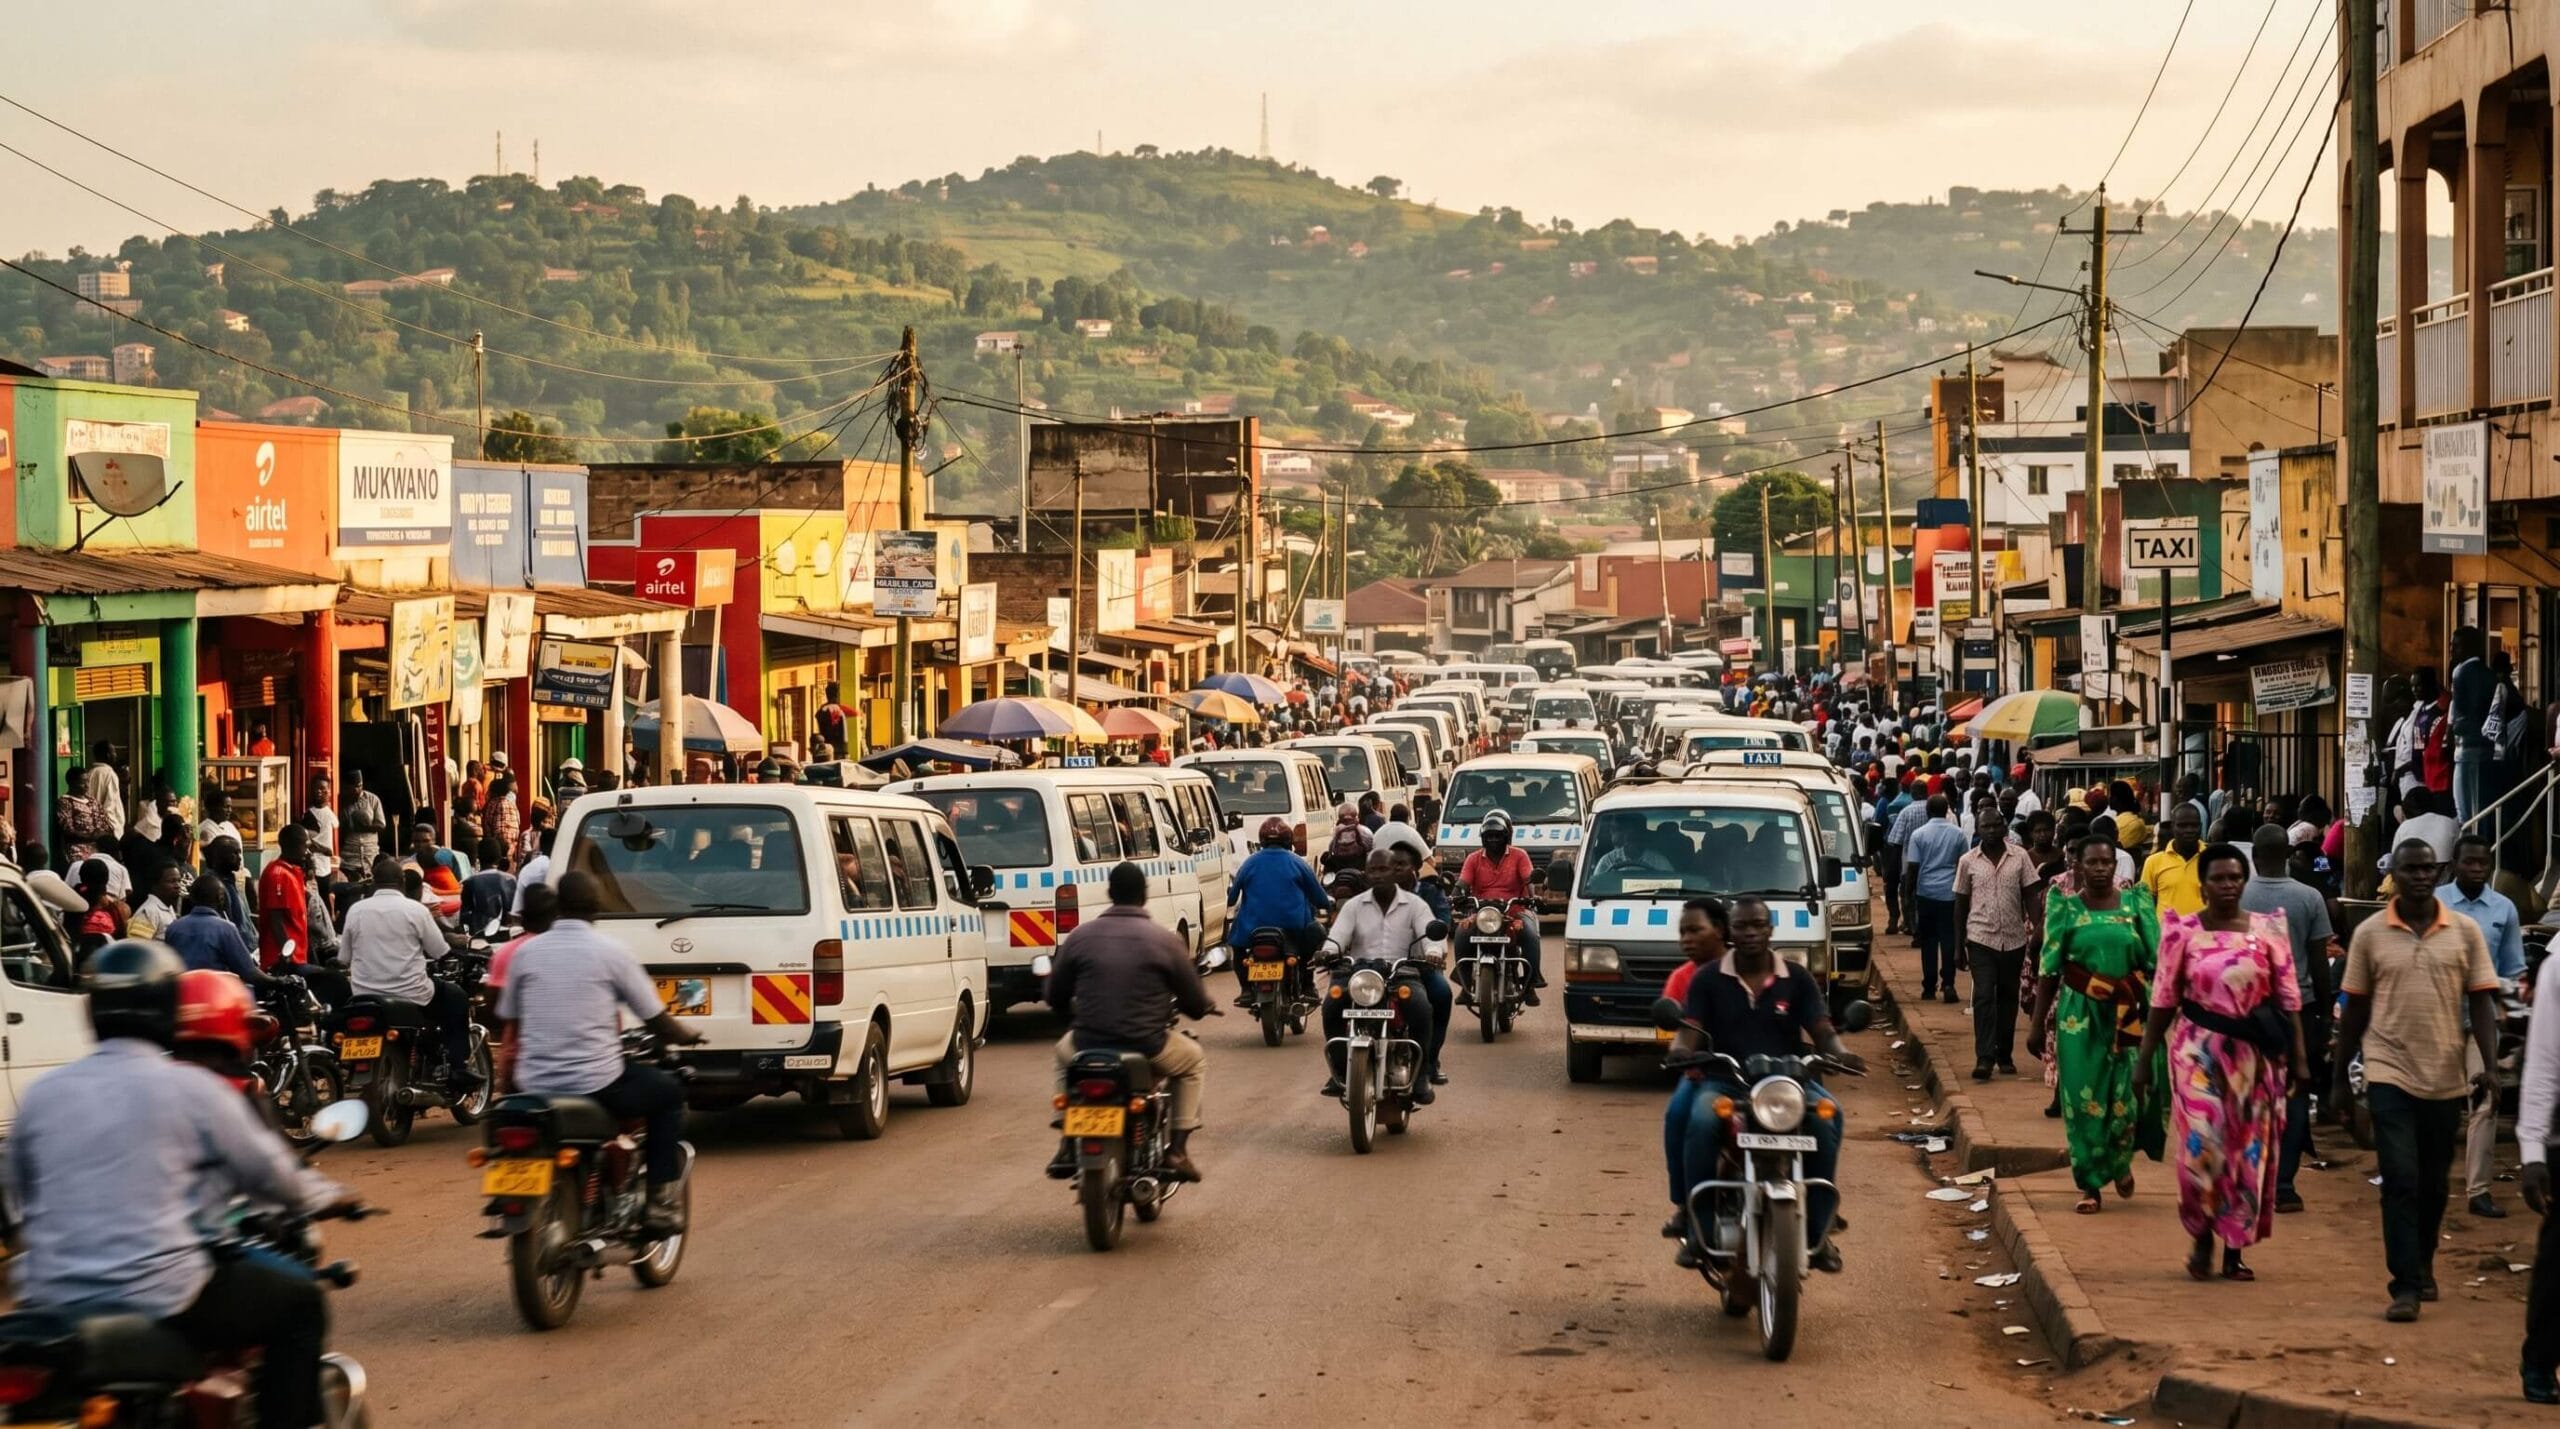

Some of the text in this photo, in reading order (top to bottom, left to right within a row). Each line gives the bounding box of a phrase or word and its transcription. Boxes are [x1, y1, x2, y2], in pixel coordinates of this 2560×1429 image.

[353, 466, 439, 500] MUKWANO
[245, 495, 287, 531] airtel
[2134, 537, 2194, 559] TAXI
[645, 579, 686, 594] airtel
